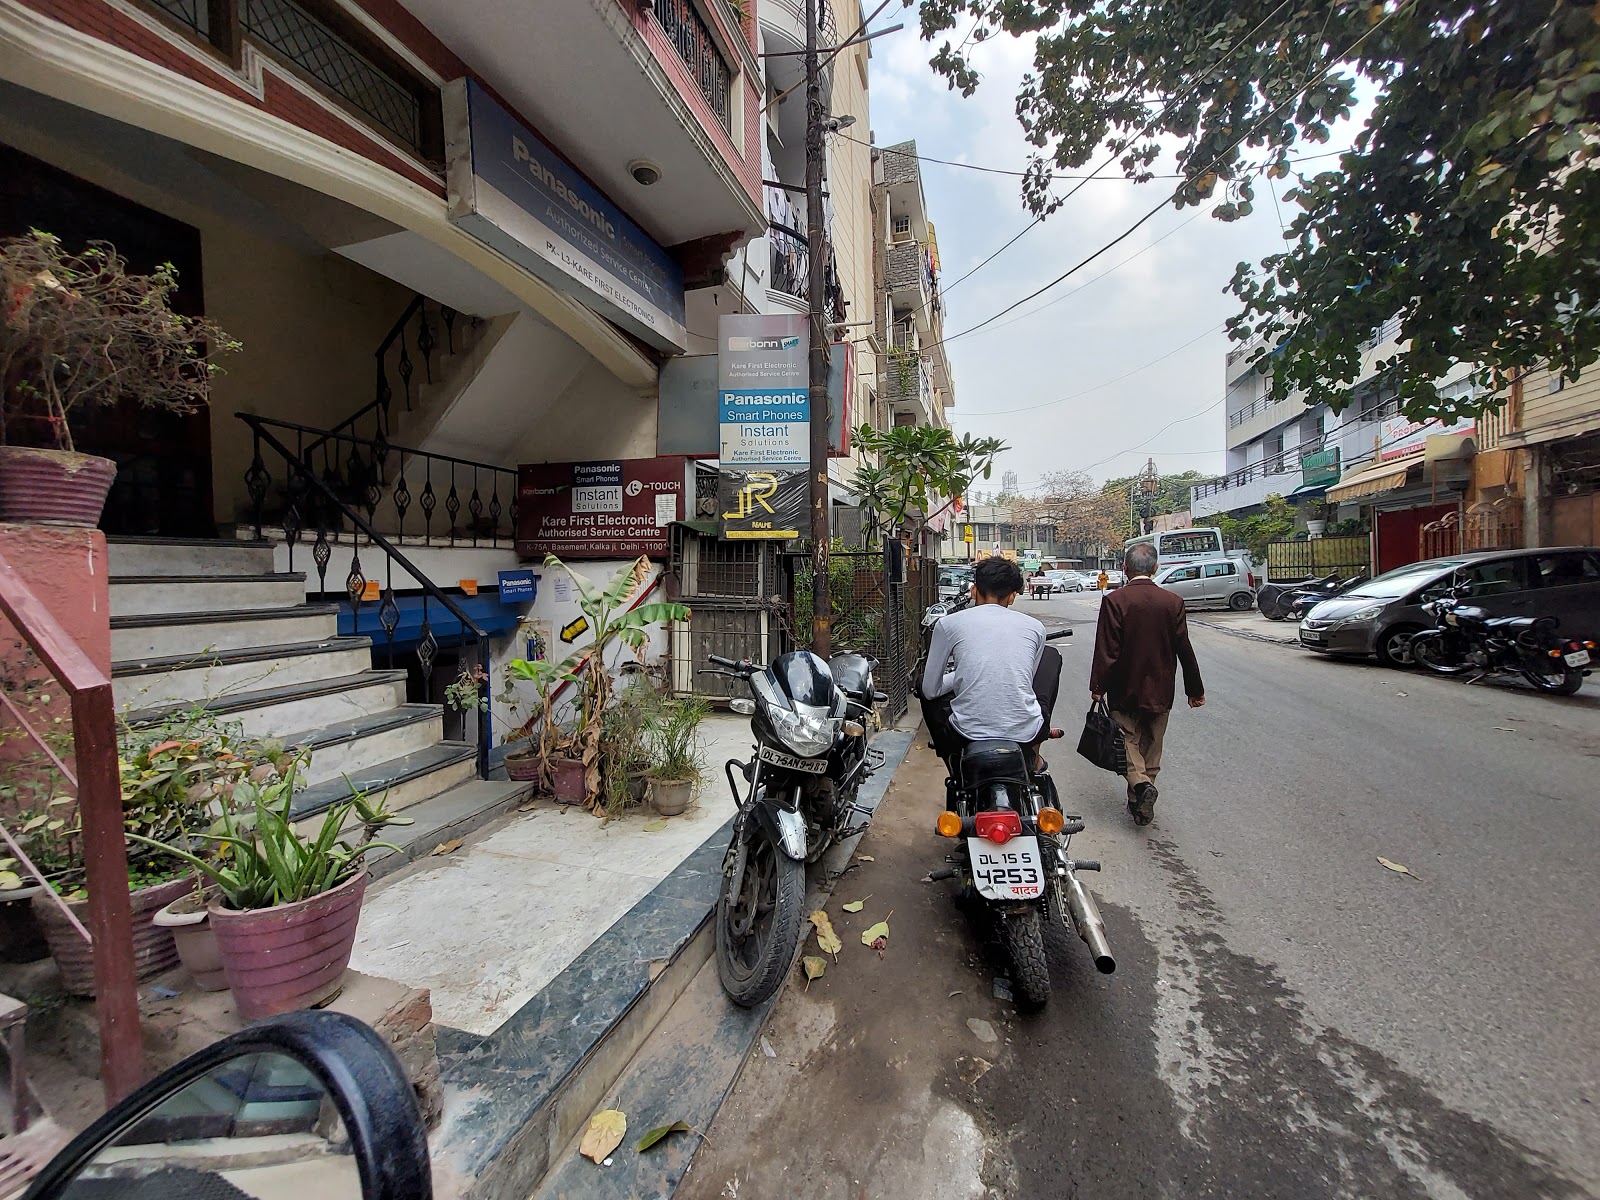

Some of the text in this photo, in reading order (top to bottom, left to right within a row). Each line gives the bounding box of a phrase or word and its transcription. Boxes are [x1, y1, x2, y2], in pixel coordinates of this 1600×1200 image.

[512, 134, 615, 239] Panasonic
[546, 206, 598, 253] Authorized
[600, 247, 628, 276] Service
[594, 275, 613, 296] FIRST
[614, 289, 655, 324] ELECTRONICS
[724, 392, 806, 405] Panasonic
[727, 410, 803, 420] Smart Phones
[740, 424, 789, 437] Instant
[574, 464, 620, 474] Panasonic
[595, 475, 619, 483] Phones
[576, 488, 619, 501] Instant
[542, 514, 655, 527] Kare First Electronic
[538, 527, 661, 537] Authorised Service Centre
[589, 542, 610, 550] Kalka
[620, 542, 640, 550] Delhi
[502, 578, 532, 586] Panasonic
[979, 854, 999, 864] DL
[976, 868, 1038, 885] 4253
[1010, 886, 1038, 895] यादव
